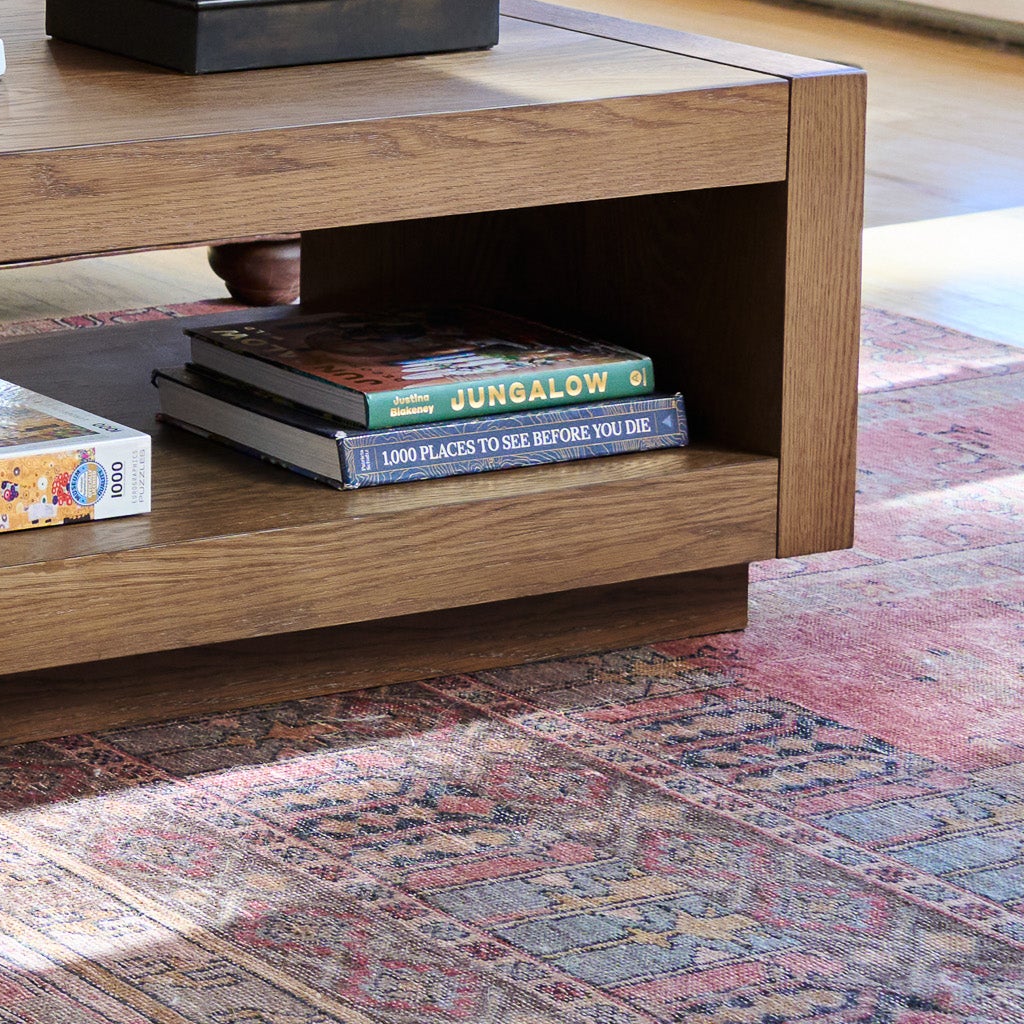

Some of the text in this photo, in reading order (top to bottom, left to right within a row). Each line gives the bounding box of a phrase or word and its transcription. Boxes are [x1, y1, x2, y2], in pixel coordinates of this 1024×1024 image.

[393, 393, 430, 406] Justina
[450, 371, 608, 411] JUNGALOW
[390, 404, 434, 417] Blakeney
[382, 417, 652, 466] 1,000 PLACES TO SEE BEFORE YOU DIE
[70, 469, 81, 502] MUSEUM
[97, 469, 106, 497] QUALITY
[111, 461, 123, 498] 1000
